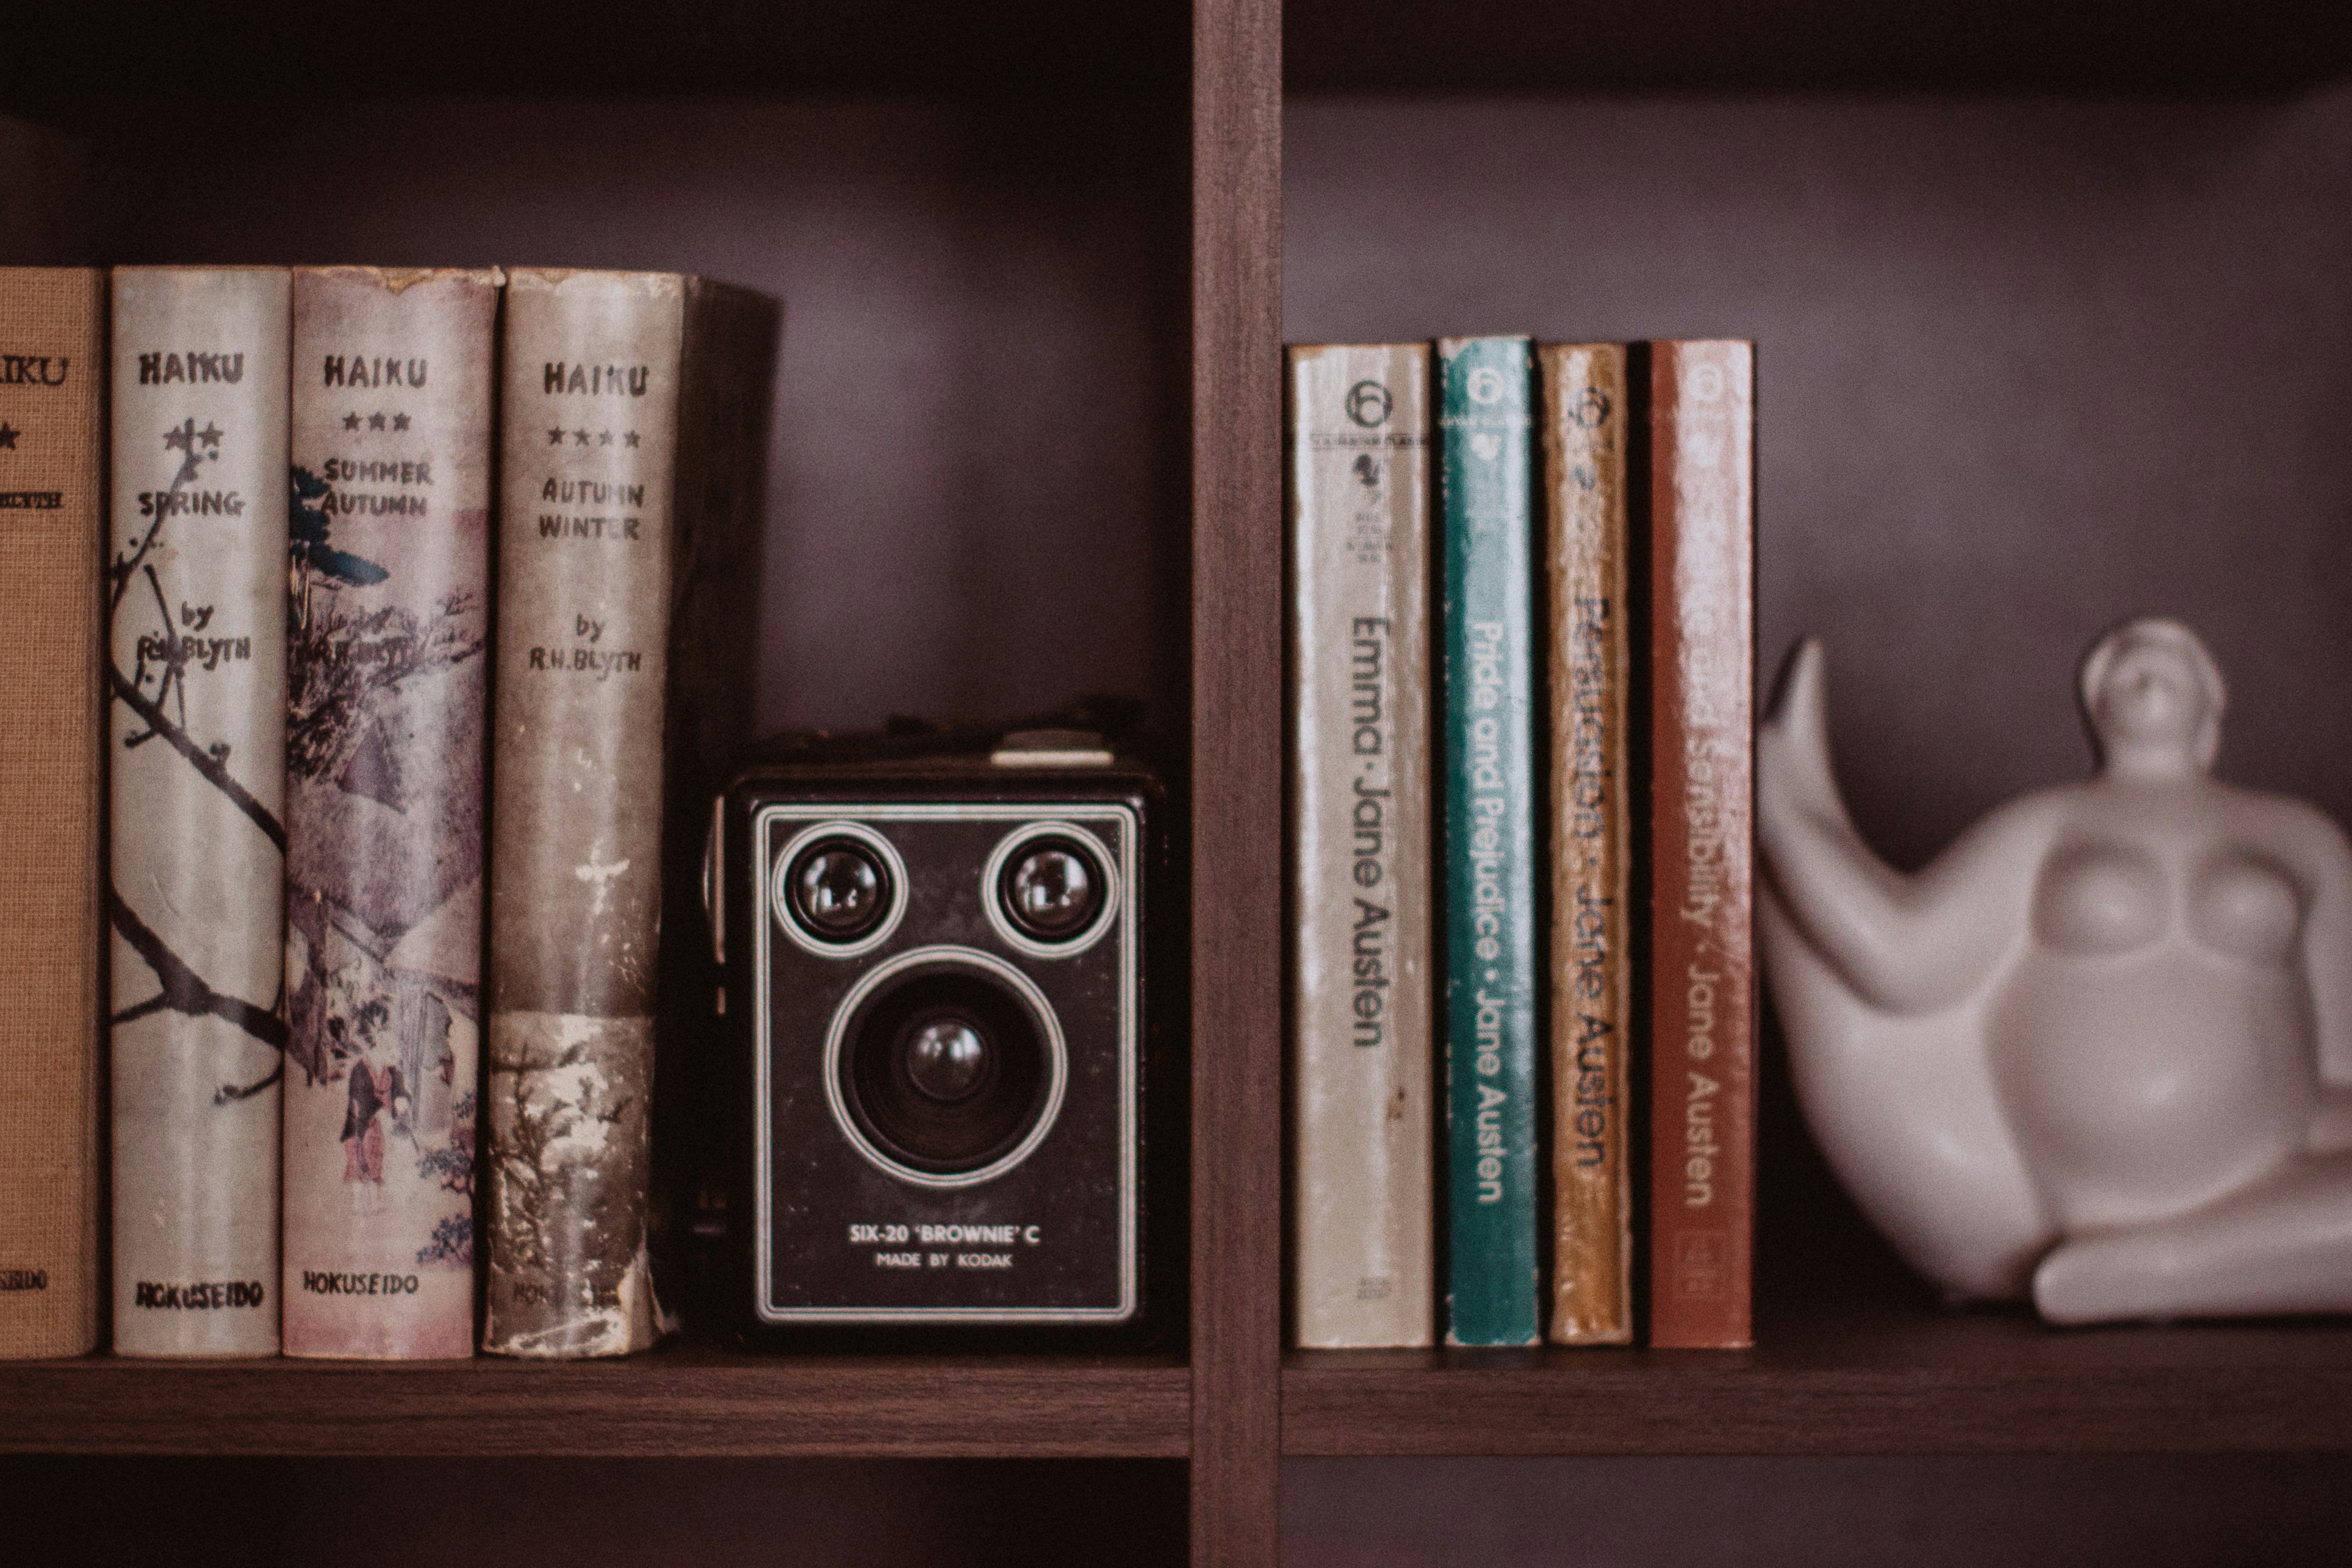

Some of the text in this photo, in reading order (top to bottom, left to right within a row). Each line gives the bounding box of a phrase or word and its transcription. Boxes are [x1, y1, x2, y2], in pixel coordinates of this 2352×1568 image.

[0, 354, 69, 386] IKU
[138, 351, 244, 386] HAIKU
[324, 355, 428, 389] HAIKU
[545, 361, 650, 397] HAIKU
[324, 457, 434, 486] SUMMER
[137, 490, 245, 517] SPRING
[320, 490, 427, 516] AUTUMN
[542, 477, 644, 508] AUTUMN
[181, 601, 214, 631] by
[576, 613, 605, 642] by
[1353, 617, 1391, 1048] Emma Jane Austen
[1573, 597, 1614, 1168] Persuasion Jane Austen
[1469, 621, 1508, 1203] Pride and Prejudice Jane Austen
[1686, 963, 1720, 1060] Jane
[1686, 1071, 1719, 1207] Austen
[850, 1225, 909, 1243] SIX-20
[1024, 1226, 1041, 1243] C
[876, 1253, 1013, 1268] MADE BY KODAK
[135, 1281, 264, 1309] HOKUSEIDO
[304, 1270, 419, 1296] HOKUSEIDO
